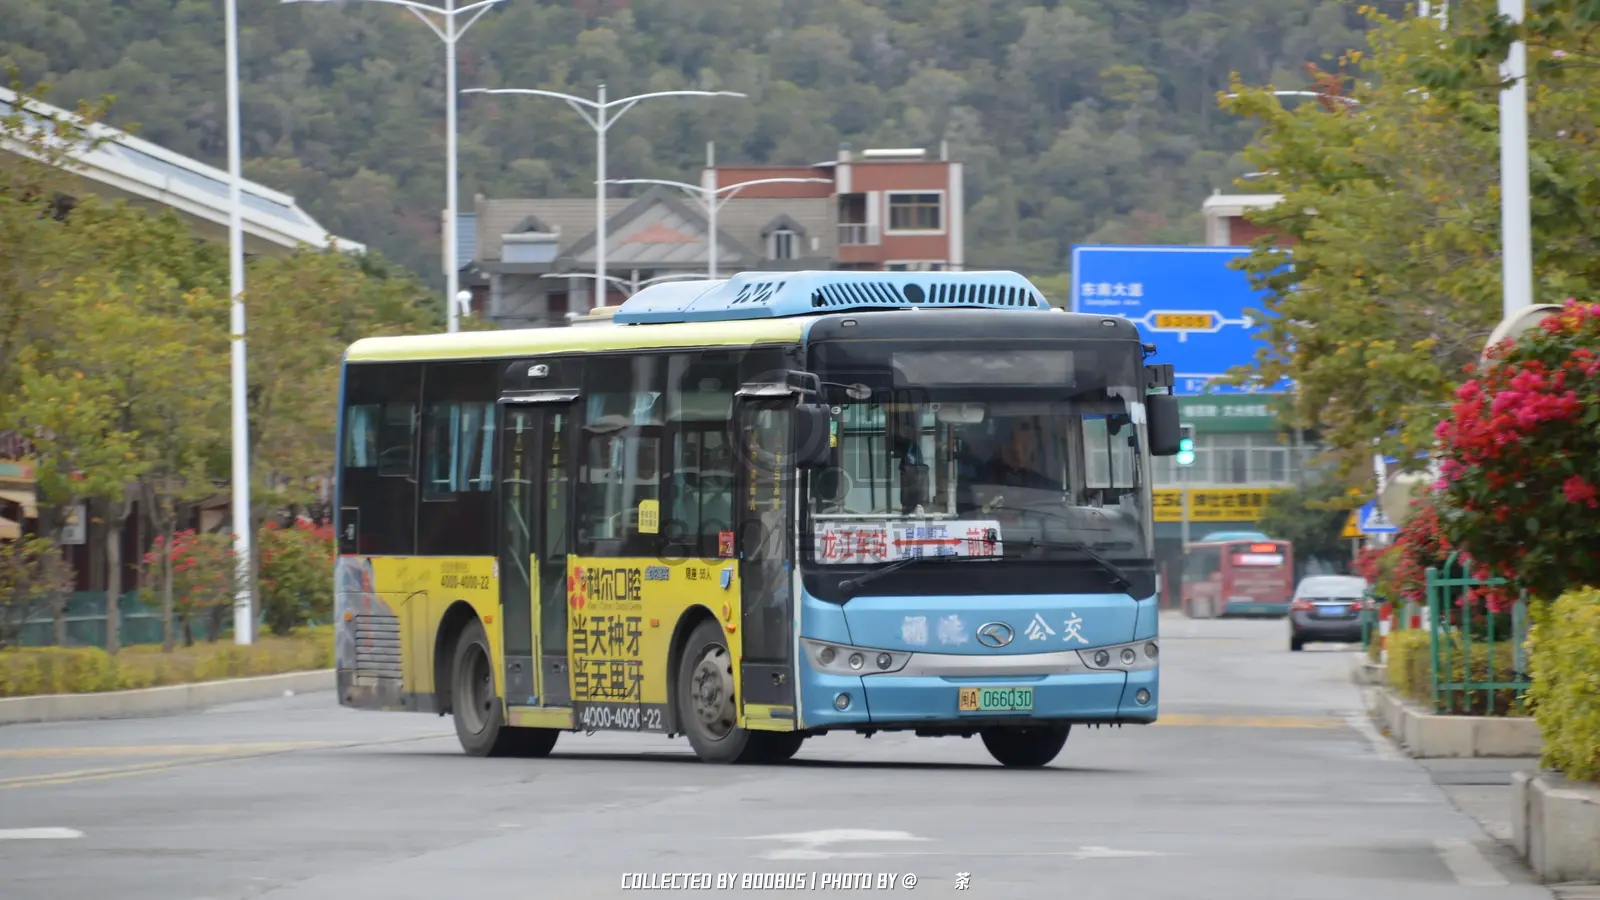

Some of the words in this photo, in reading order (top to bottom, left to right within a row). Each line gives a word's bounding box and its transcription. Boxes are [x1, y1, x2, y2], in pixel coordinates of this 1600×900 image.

[821, 529, 888, 559] 龙江车站
[587, 568, 642, 600] 科尔口腔
[573, 614, 643, 656] 当天种牙
[1024, 612, 1089, 644] 公交
[983, 690, 1032, 707] 06603D
